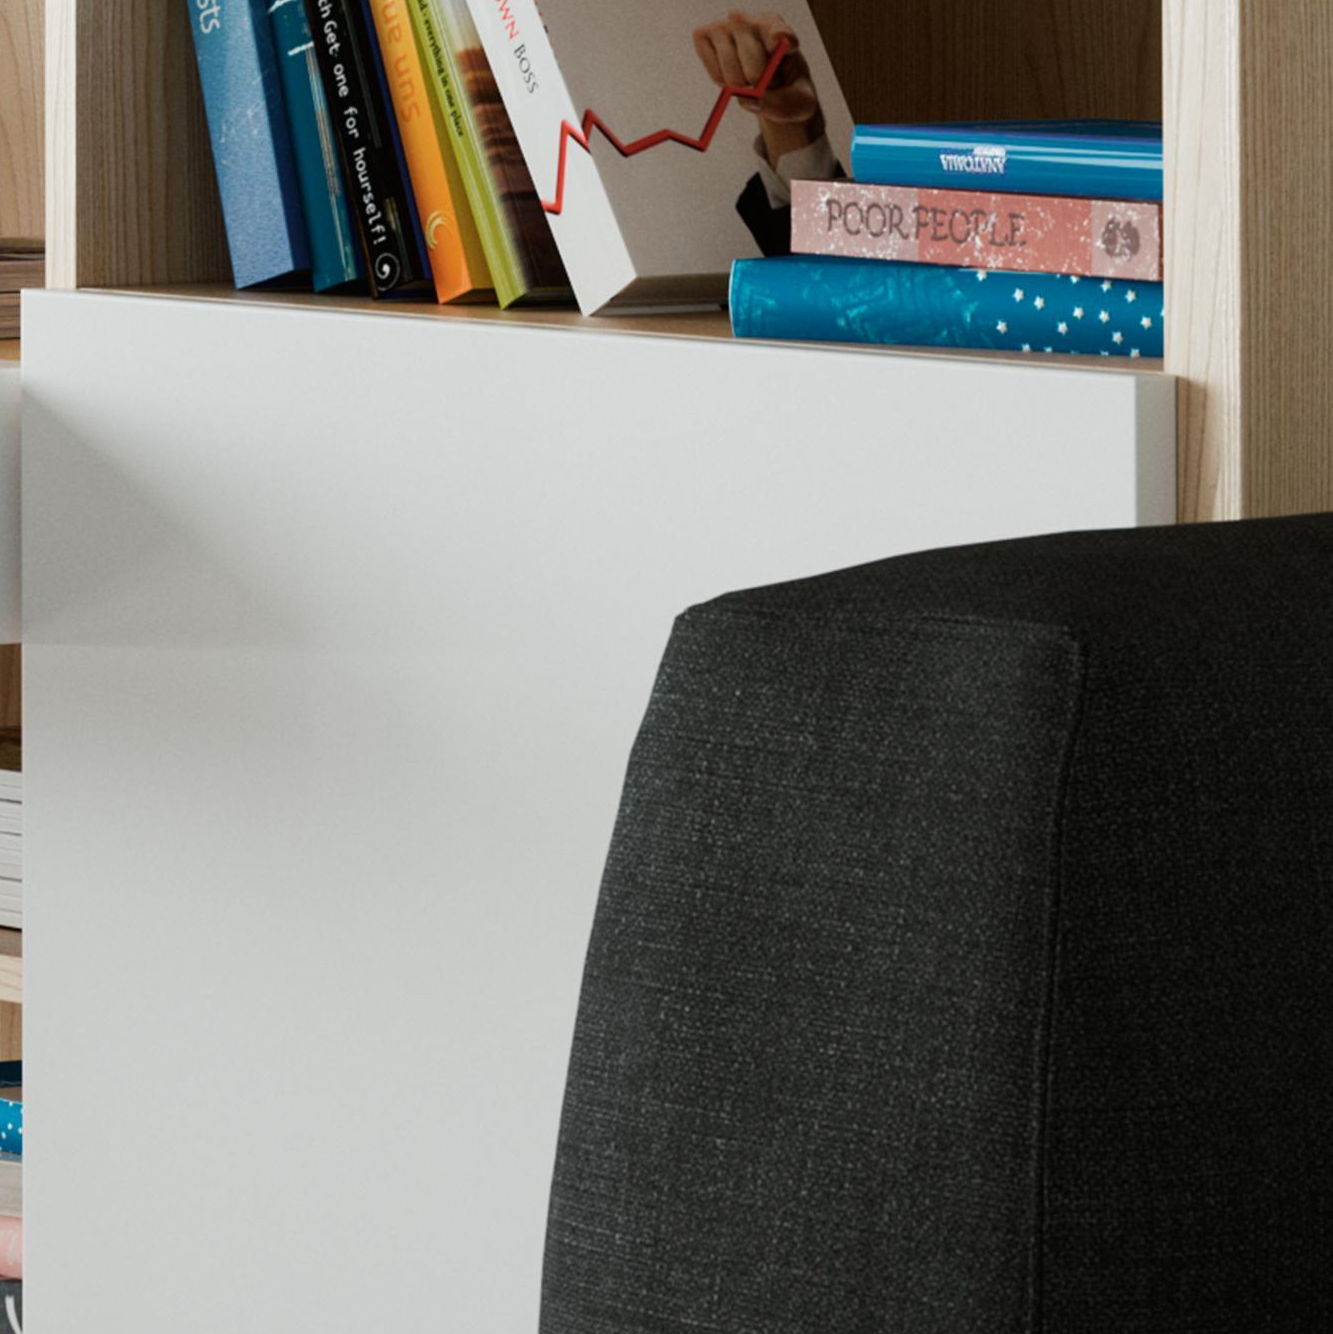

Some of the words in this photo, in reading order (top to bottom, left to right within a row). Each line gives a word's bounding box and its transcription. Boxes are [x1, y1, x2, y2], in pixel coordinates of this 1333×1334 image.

[323, 19, 339, 54] Get
[333, 64, 350, 99] one
[343, 105, 360, 138] for
[513, 43, 540, 95] BOSS
[825, 198, 910, 241] POOR
[912, 205, 1026, 248] PEOPLE
